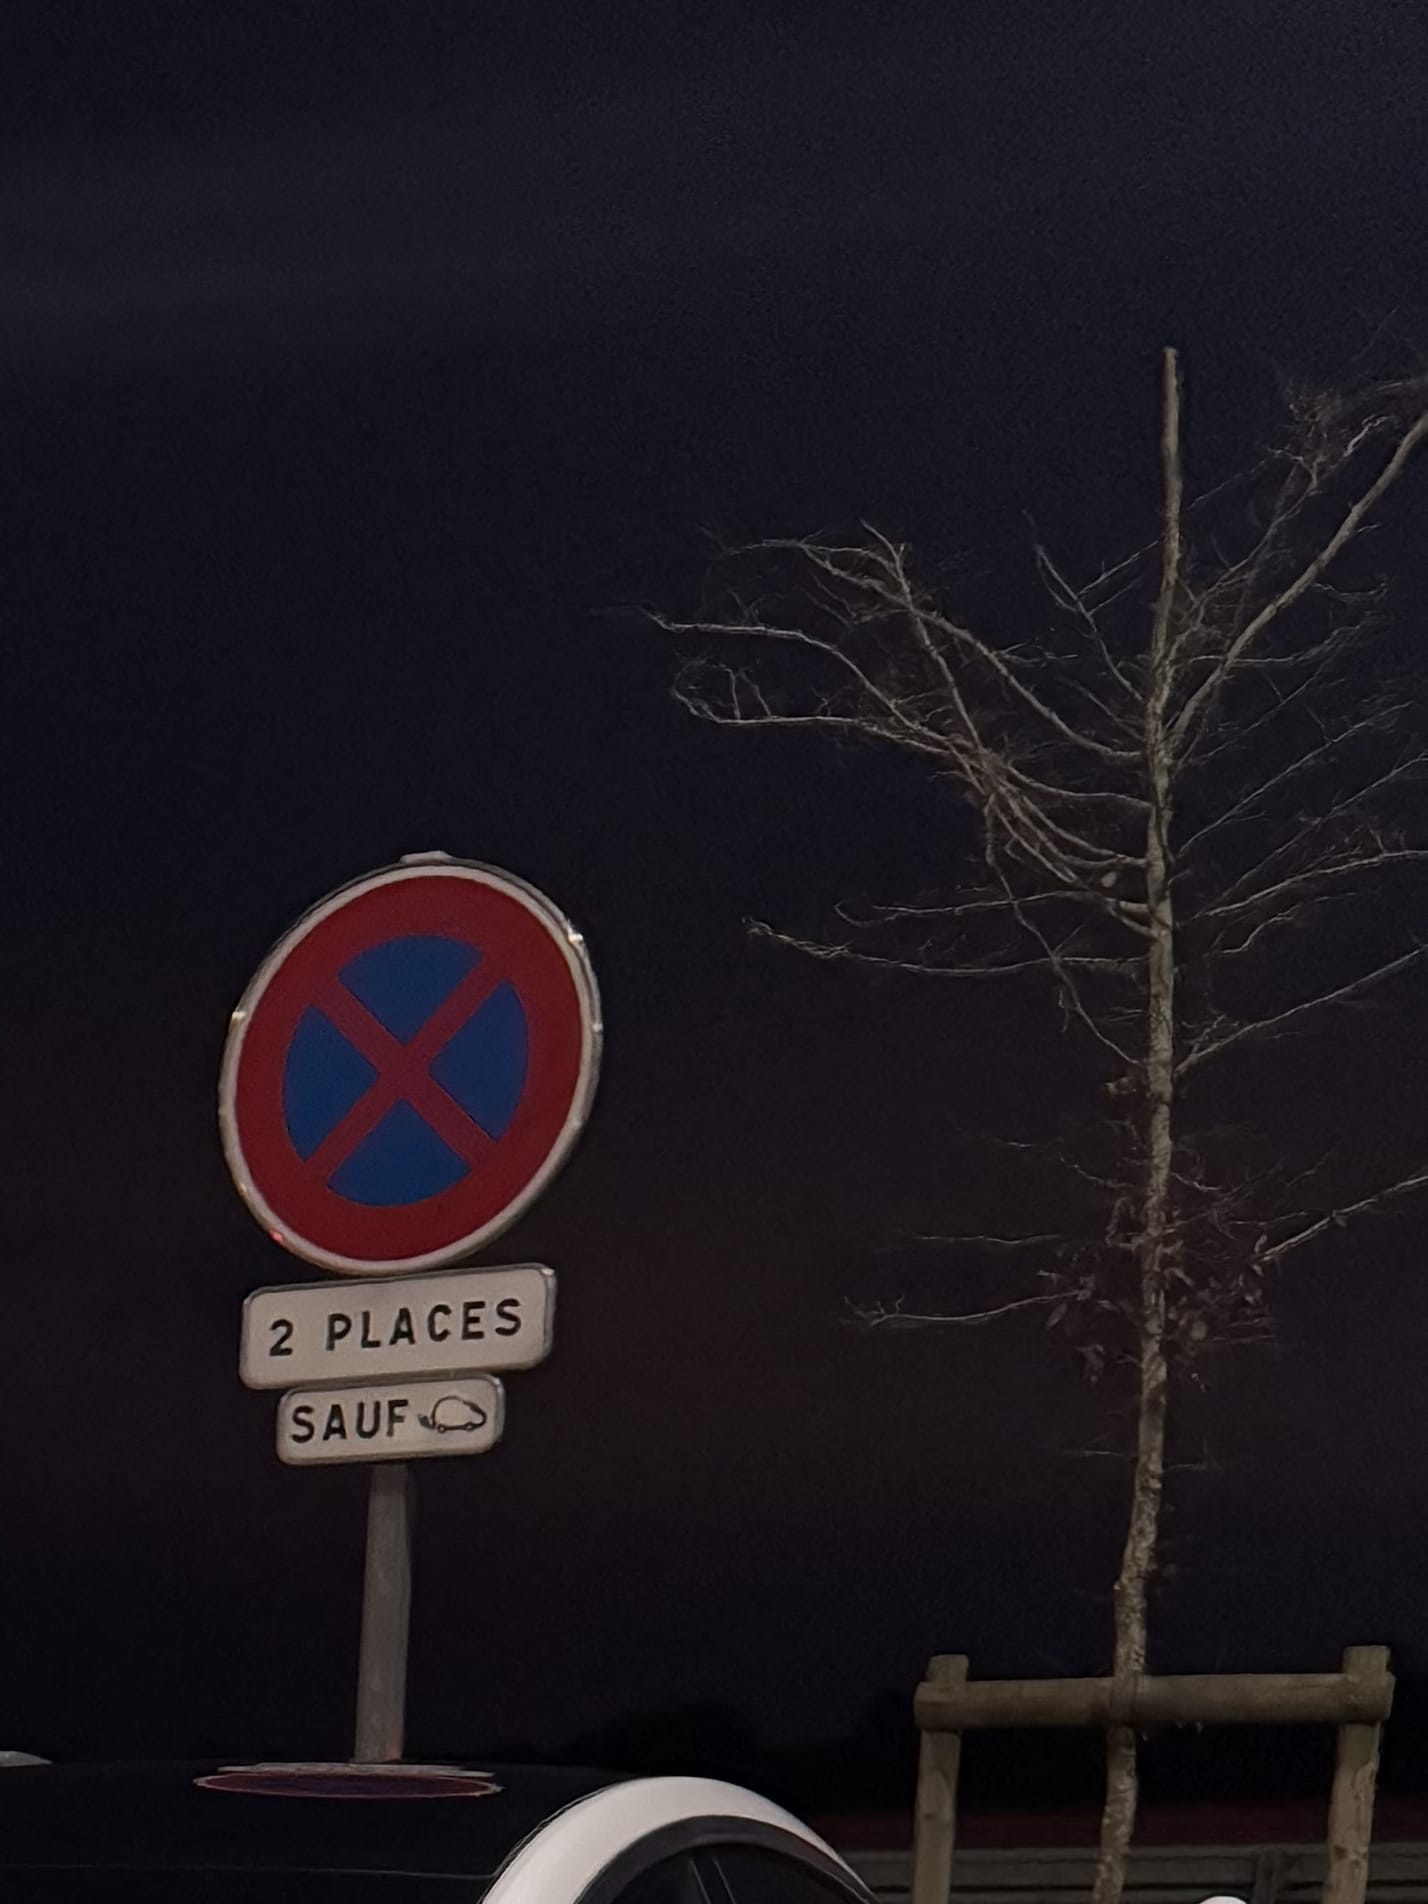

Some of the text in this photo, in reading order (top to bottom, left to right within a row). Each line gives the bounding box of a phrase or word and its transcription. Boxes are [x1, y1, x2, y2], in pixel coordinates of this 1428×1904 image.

[269, 1298, 522, 1357] 2 PLACES
[291, 1399, 409, 1443] SAUF
